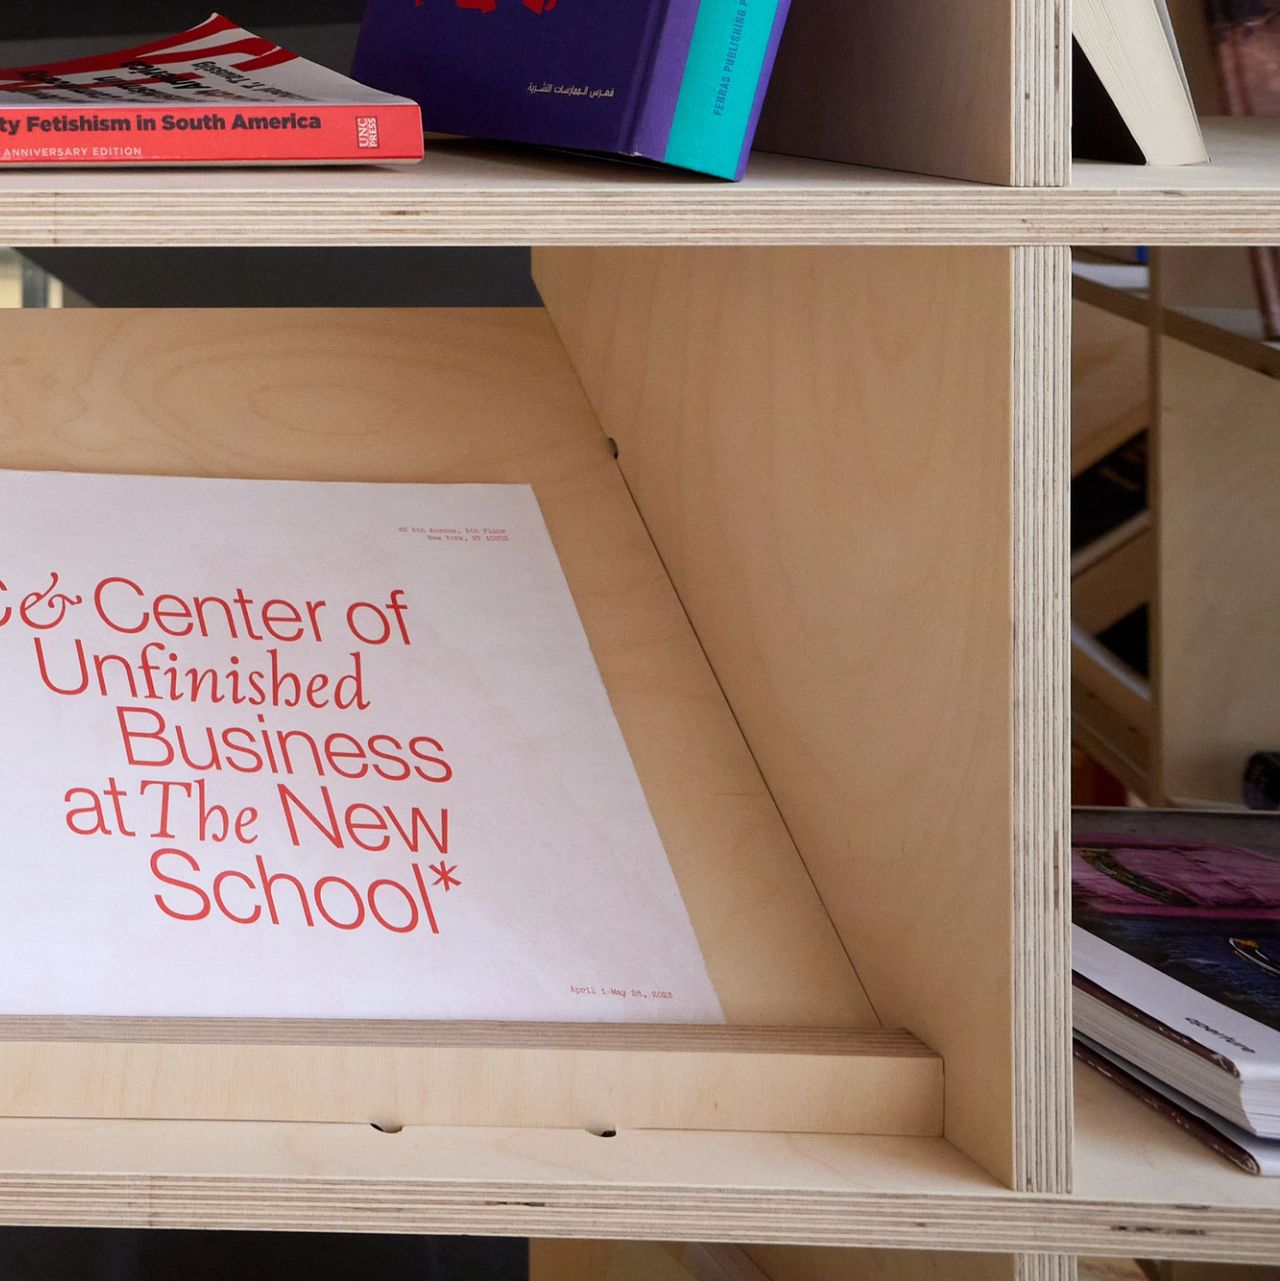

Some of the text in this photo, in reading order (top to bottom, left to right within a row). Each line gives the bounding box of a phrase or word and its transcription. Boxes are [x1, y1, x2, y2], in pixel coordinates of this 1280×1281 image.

[713, 76, 731, 116] FEHRAS
[723, 9, 747, 73] PUBLISHING
[27, 115, 130, 133] Fetishism
[137, 114, 156, 131] in
[161, 113, 226, 130] South
[231, 112, 321, 130] America
[358, 117, 369, 148] UNC
[369, 117, 378, 147] PRESS
[3, 147, 88, 158] ANNIVERSARY
[92, 146, 142, 156] EDITION
[94, 576, 326, 643] Center
[346, 588, 411, 646] of
[33, 637, 371, 711] Unfinished
[116, 705, 453, 783] Business
[63, 776, 449, 854] at The New
[1185, 1017, 1256, 1054] aperture
